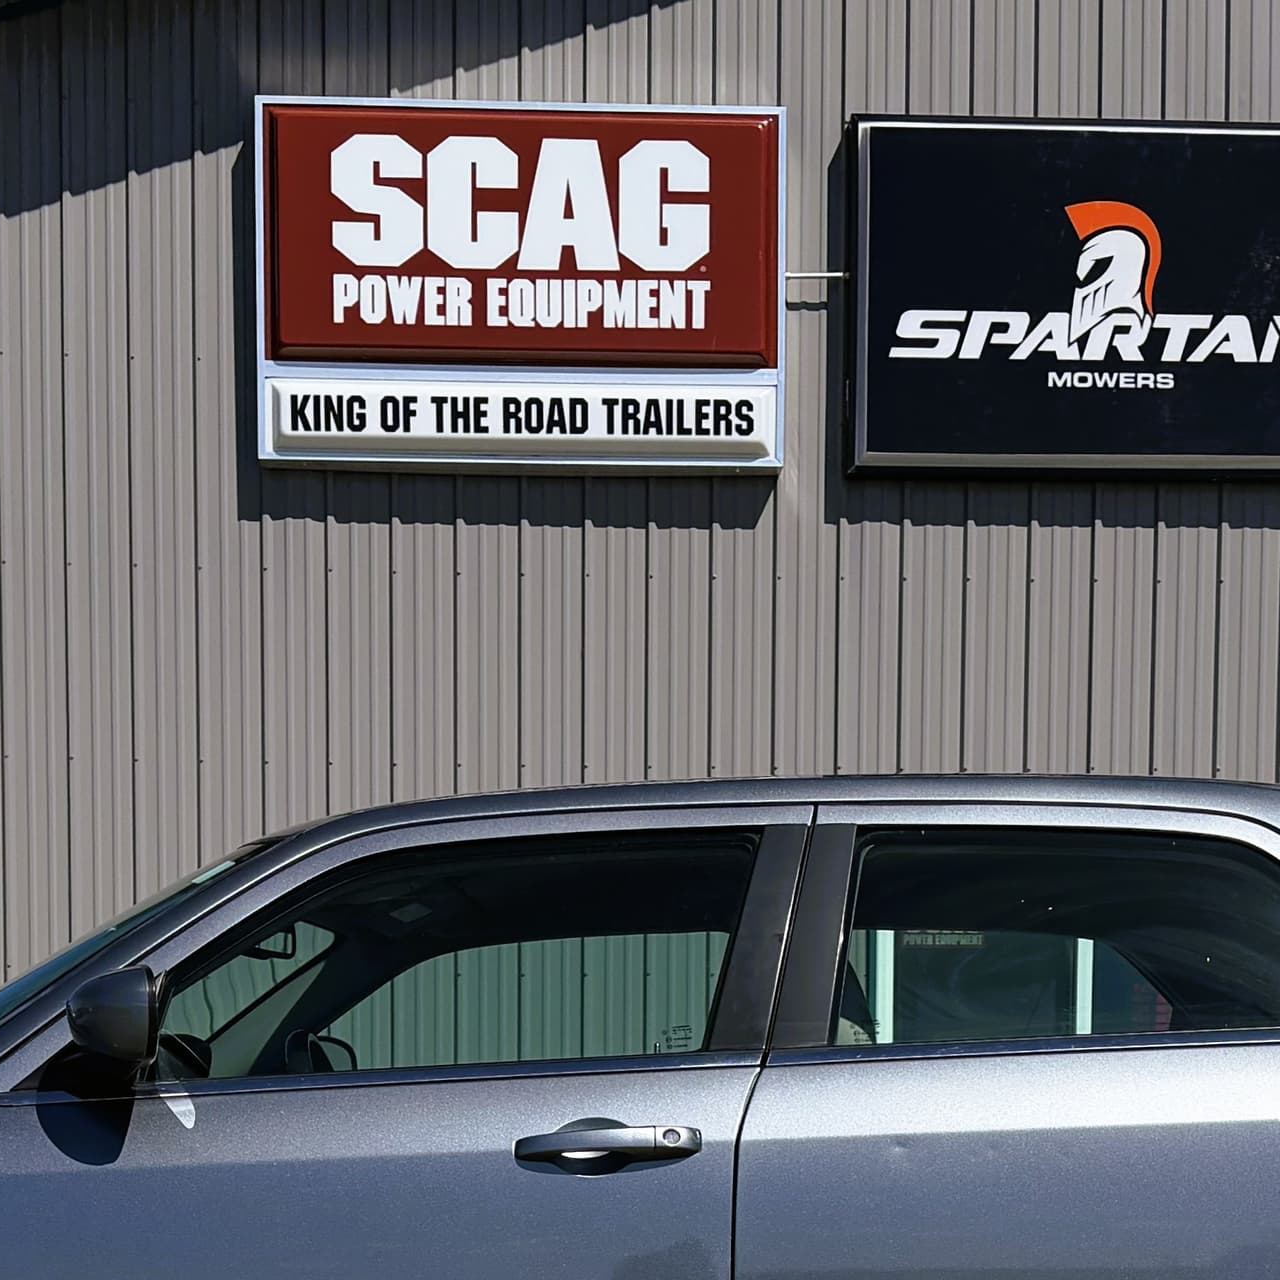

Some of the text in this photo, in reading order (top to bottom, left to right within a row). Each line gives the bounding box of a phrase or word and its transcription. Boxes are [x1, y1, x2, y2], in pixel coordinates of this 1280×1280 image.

[331, 133, 711, 272] SCAG
[333, 274, 711, 330] POWER EQUIPMENT
[1047, 371, 1174, 389] MOWERS
[290, 394, 755, 437] KING OF THE ROAD TRAILERS
